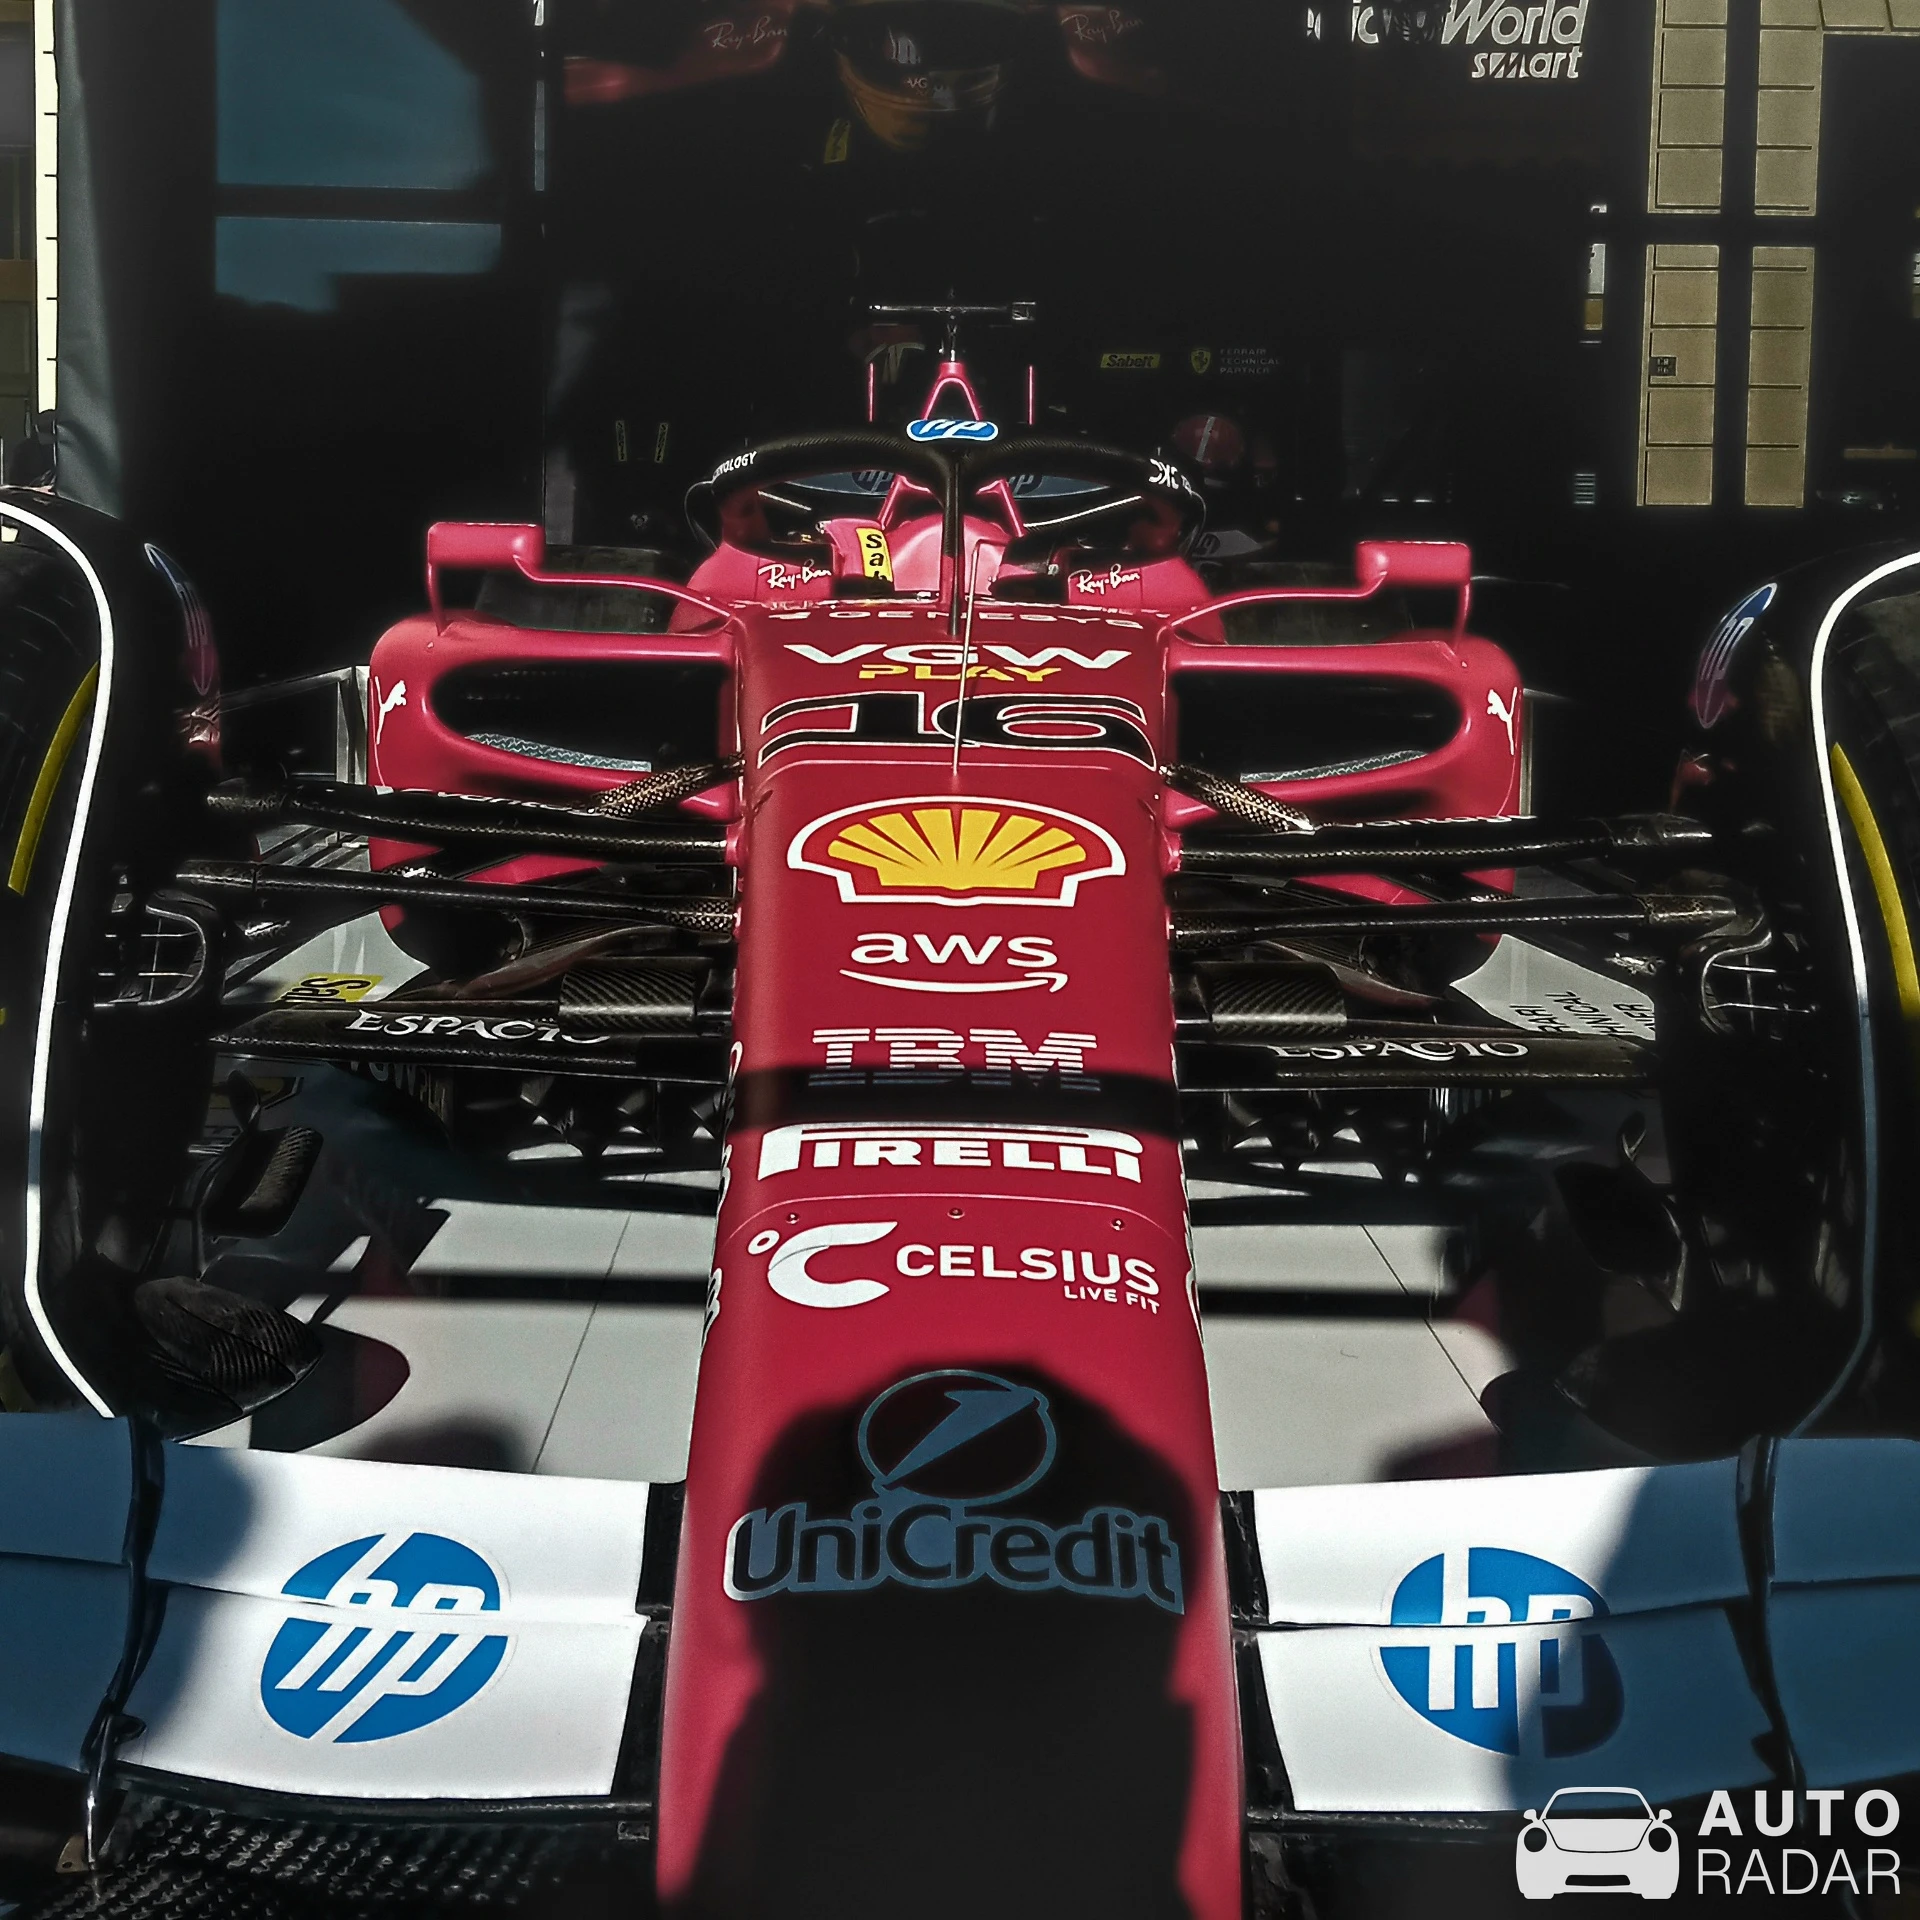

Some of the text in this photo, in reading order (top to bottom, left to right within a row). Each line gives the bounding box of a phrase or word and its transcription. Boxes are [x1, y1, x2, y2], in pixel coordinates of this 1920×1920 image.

[1441, 0, 1589, 44] World
[758, 559, 832, 590] Ray-Ban
[1069, 564, 1140, 595] Ray-Ban
[784, 643, 1132, 669] VGW
[858, 664, 1062, 682] PLAY
[757, 691, 1157, 772] 16
[851, 932, 1058, 968] aws
[808, 1028, 1101, 1092] IBM
[757, 1122, 1144, 1183] PIRELLI
[896, 1244, 1161, 1297] CELSIUS
[1063, 1284, 1161, 1315] LIVE FIT
[728, 1503, 1181, 1608] UniCredit
[270, 1532, 503, 1743] hp
